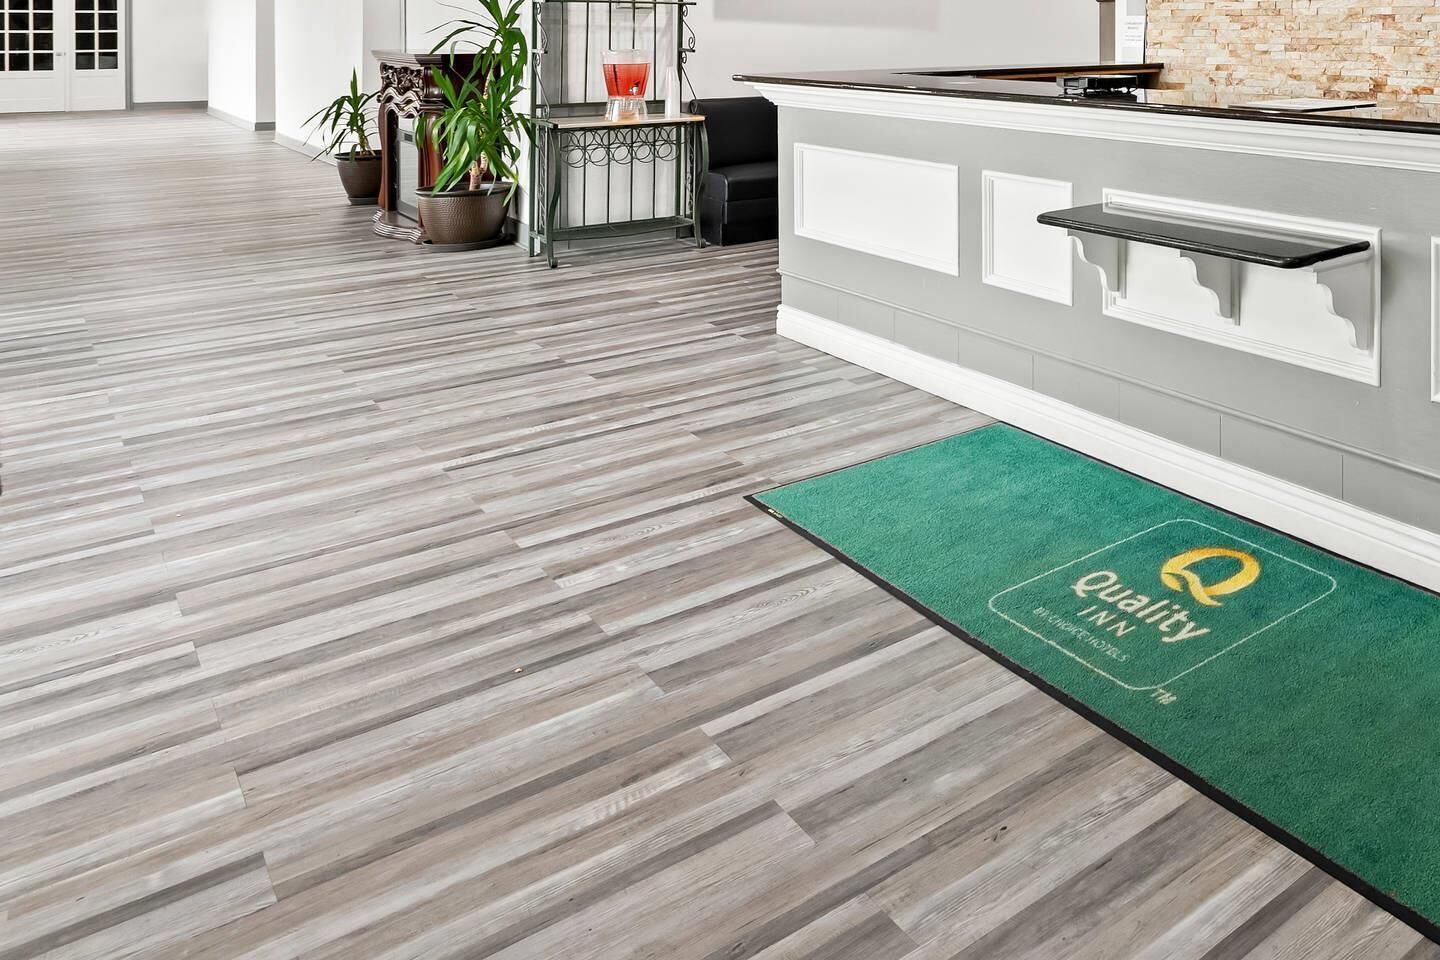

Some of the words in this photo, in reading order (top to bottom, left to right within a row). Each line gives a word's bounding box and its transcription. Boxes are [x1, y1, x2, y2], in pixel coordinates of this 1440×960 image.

[1071, 570, 1211, 642] Quality
[1161, 547, 1260, 607] Q
[1077, 605, 1137, 637] INN
